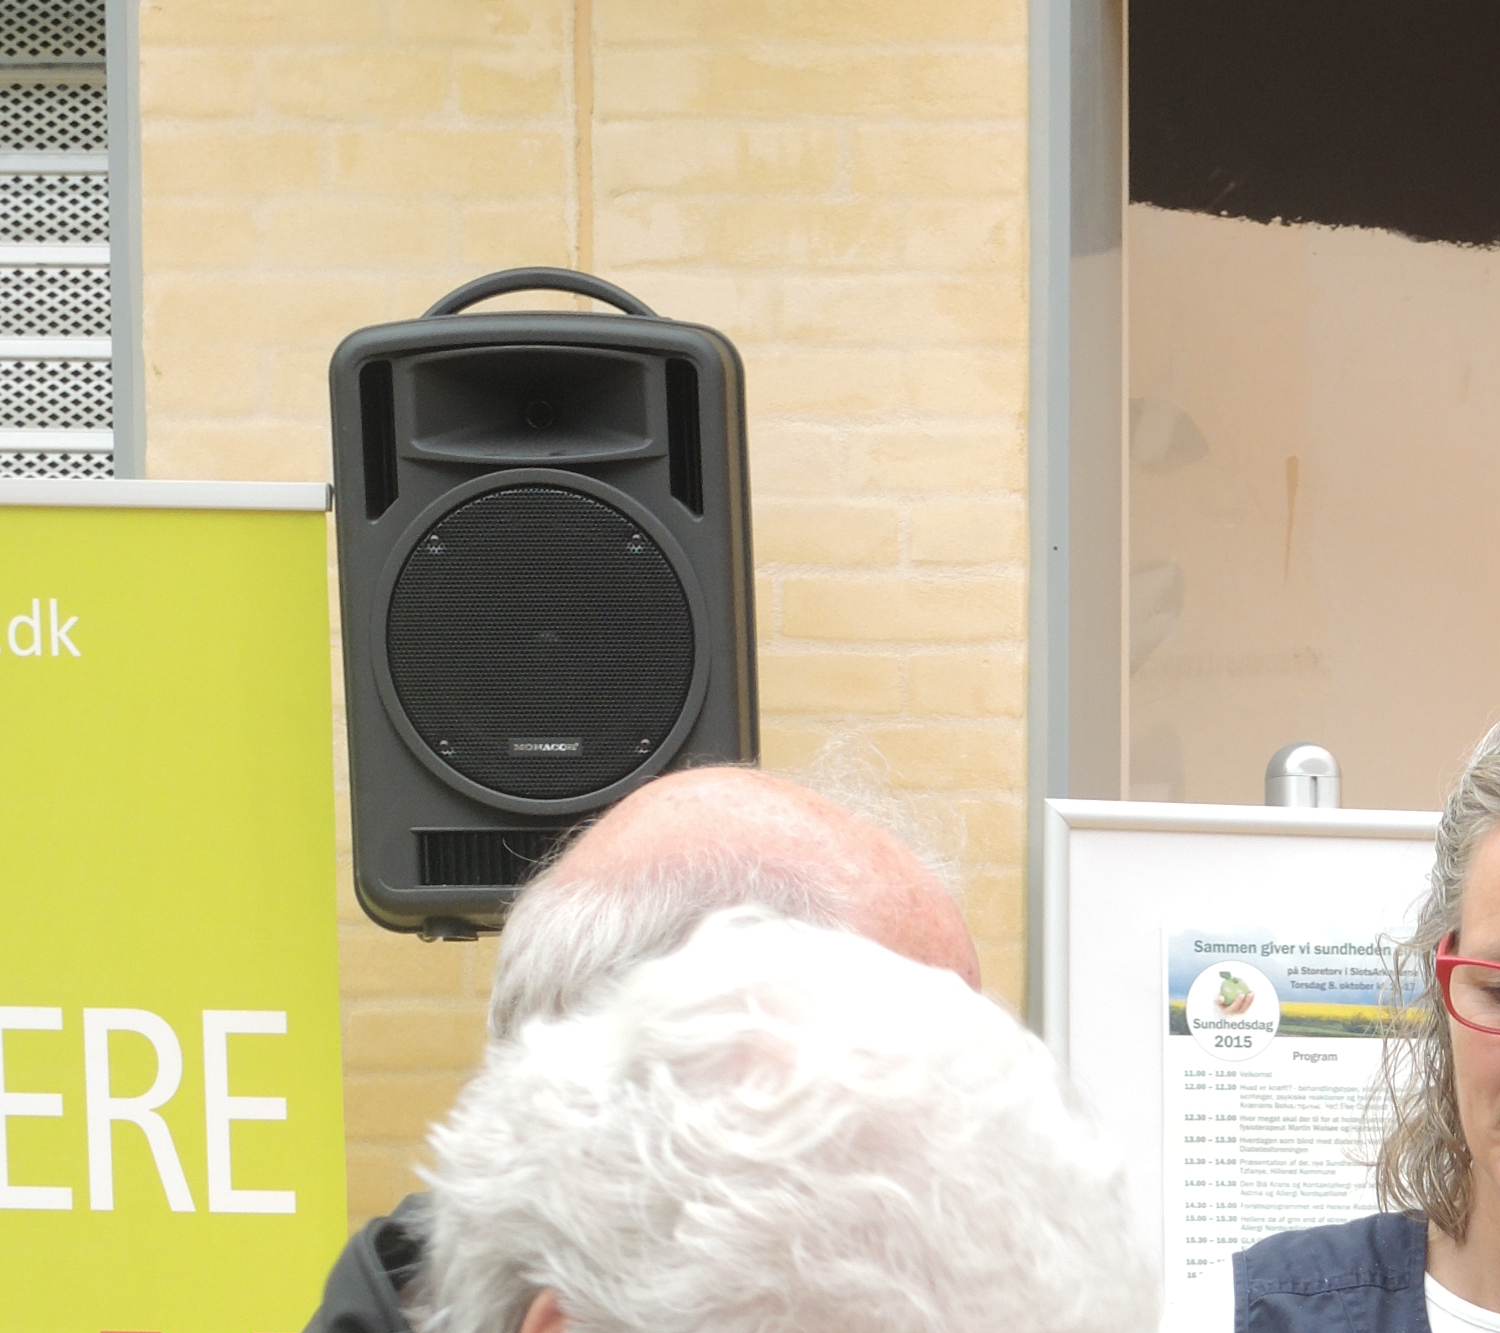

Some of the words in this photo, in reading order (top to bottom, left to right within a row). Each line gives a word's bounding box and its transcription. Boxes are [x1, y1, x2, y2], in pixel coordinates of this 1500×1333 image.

[0, 598, 82, 658] dk
[1193, 940, 1257, 954] Sammen
[1261, 941, 1294, 957] giver
[1299, 942, 1310, 955] vi
[1314, 943, 1391, 956] sundheden
[1287, 966, 1299, 976] på
[1301, 967, 1343, 976] Storetorv
[1290, 980, 1326, 991] Torsdag
[1329, 981, 1338, 990] 8.
[1340, 982, 1373, 991] oktober
[1193, 1019, 1273, 1032] Sundhedsdag
[1214, 1035, 1252, 1048] 2015
[1293, 1051, 1338, 1063] Program
[0, 1006, 296, 1214] ERE
